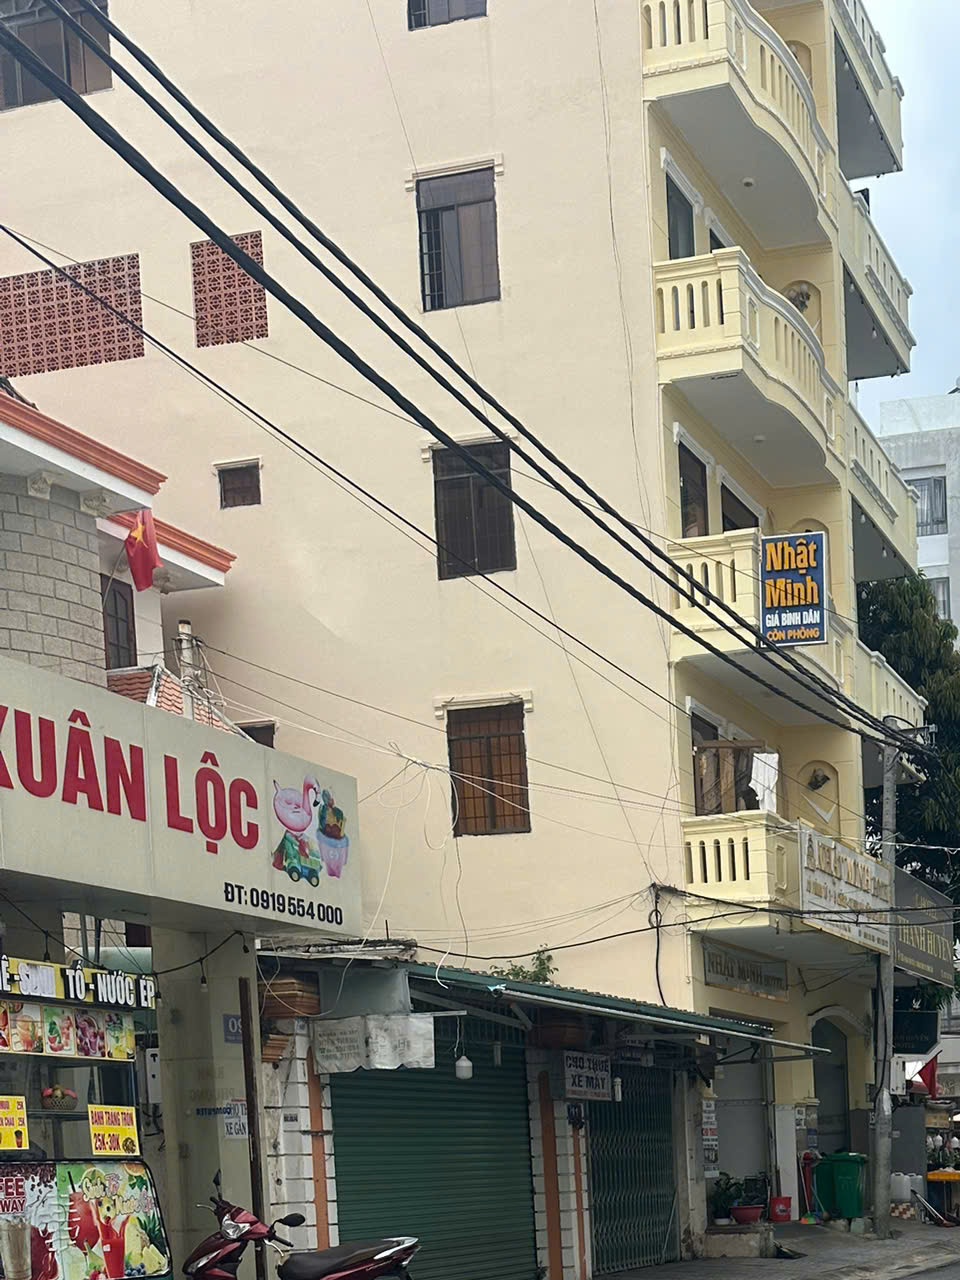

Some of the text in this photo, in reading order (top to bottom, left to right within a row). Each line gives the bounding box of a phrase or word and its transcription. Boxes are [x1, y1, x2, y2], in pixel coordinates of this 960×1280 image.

[765, 538, 817, 576] Nhật
[764, 576, 819, 609] Minh
[765, 607, 820, 628] GIÁ BÌNH DÂN
[766, 626, 820, 642] CÒN PHÒNG
[164, 751, 260, 854] LỘC
[224, 882, 343, 926] ĐT: 0919 554 000
[65, 960, 86, 1000] TỐ
[96, 969, 134, 1006] NƯỚC
[571, 1074, 584, 1088] XE
